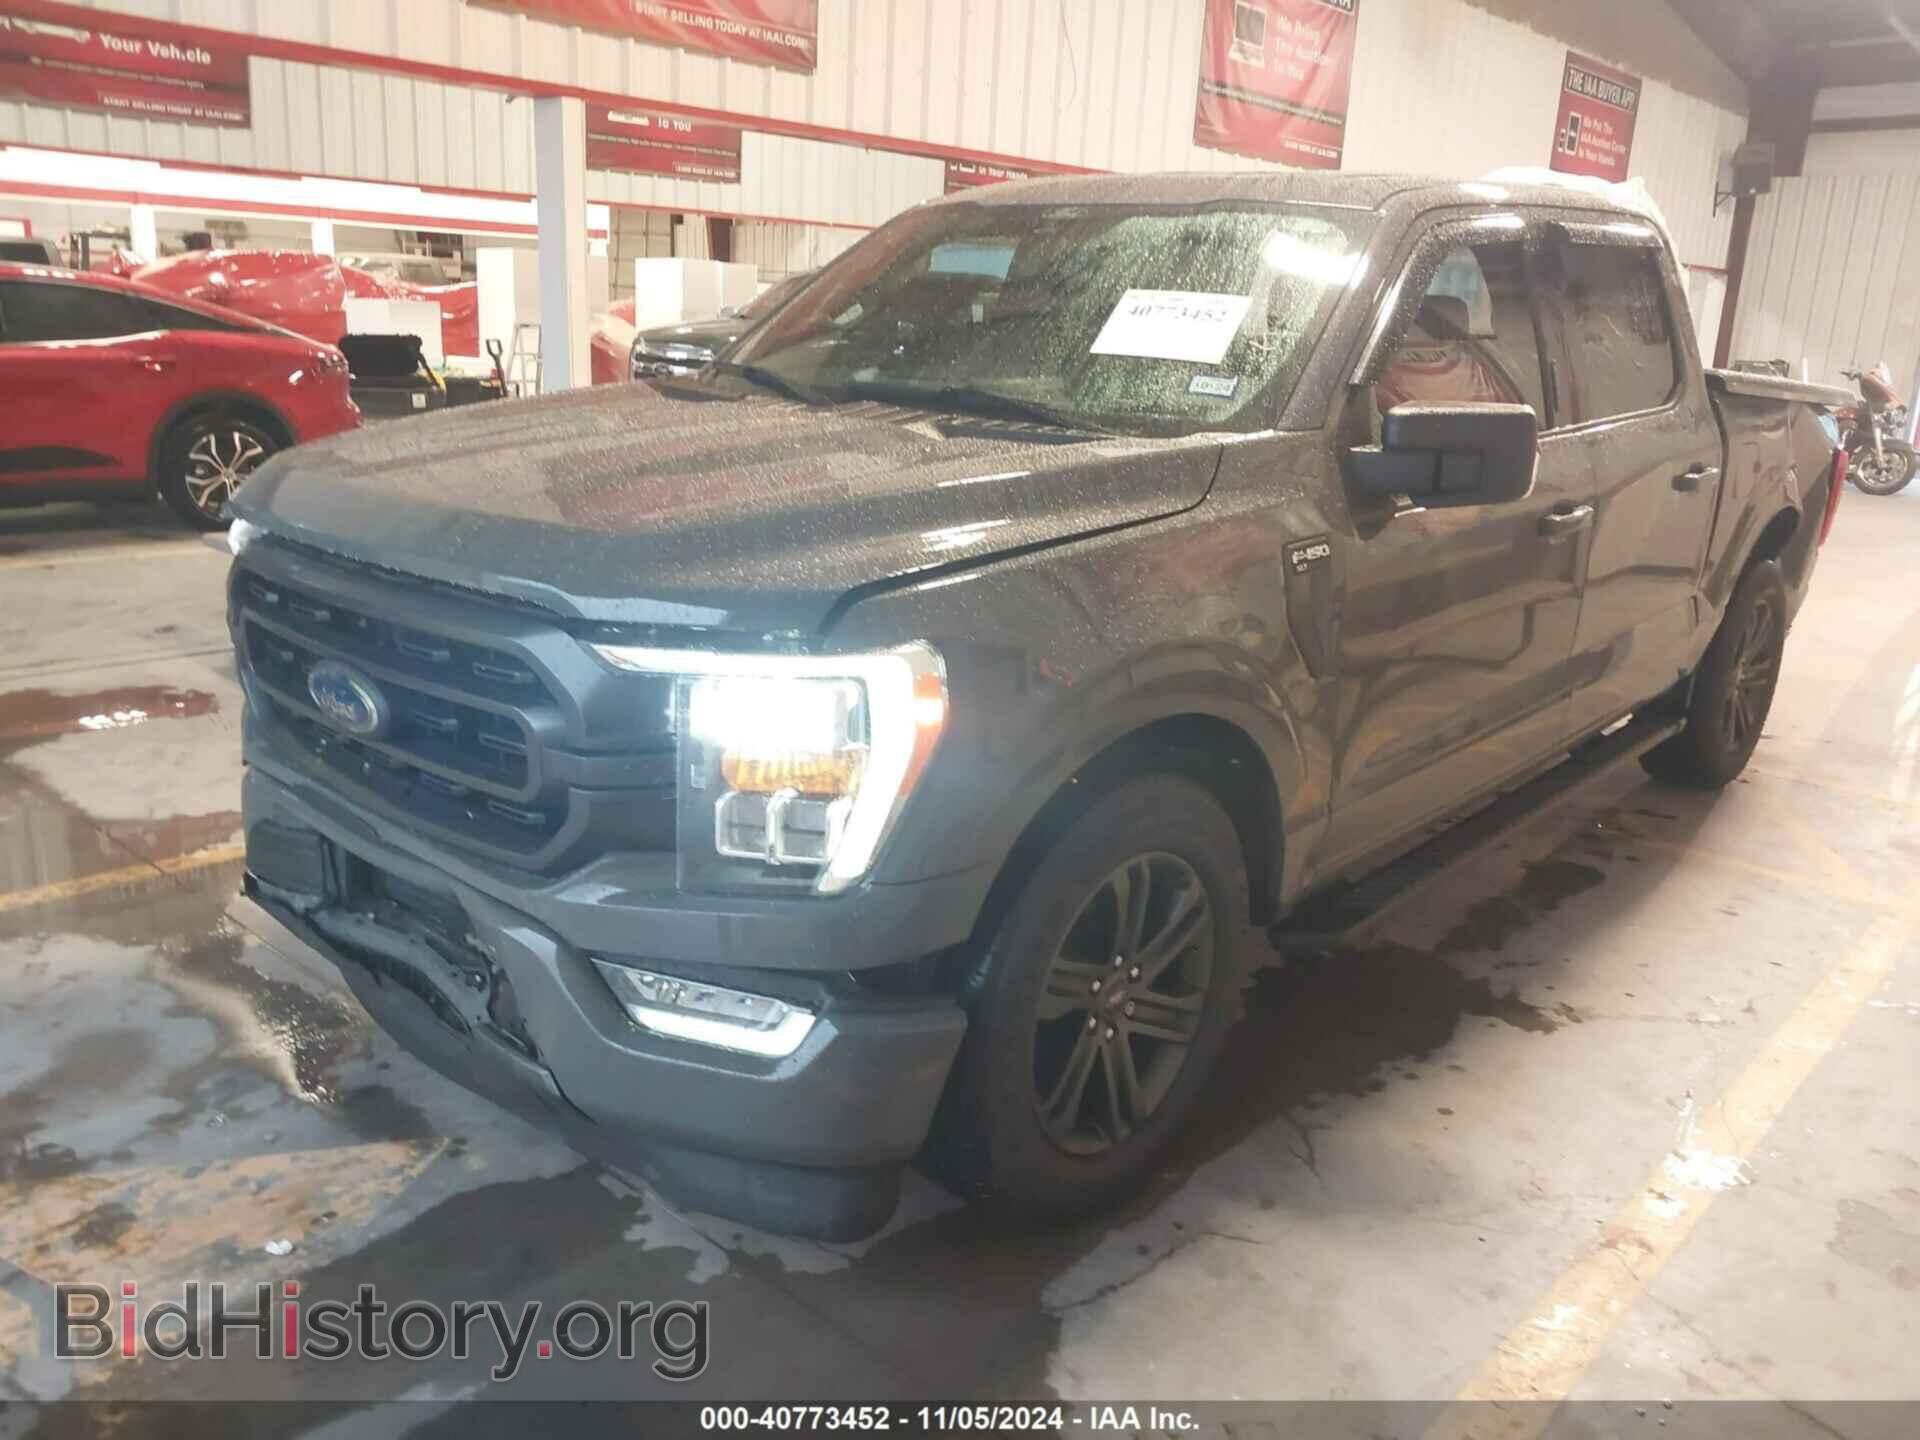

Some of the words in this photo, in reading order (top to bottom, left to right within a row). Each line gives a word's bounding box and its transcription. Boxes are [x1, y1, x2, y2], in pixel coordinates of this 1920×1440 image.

[671, 10, 713, 30] SELLING
[715, 16, 746, 37] TODAY
[749, 26, 761, 39] AT
[99, 33, 142, 53] Your
[1568, 69, 1584, 92] THE
